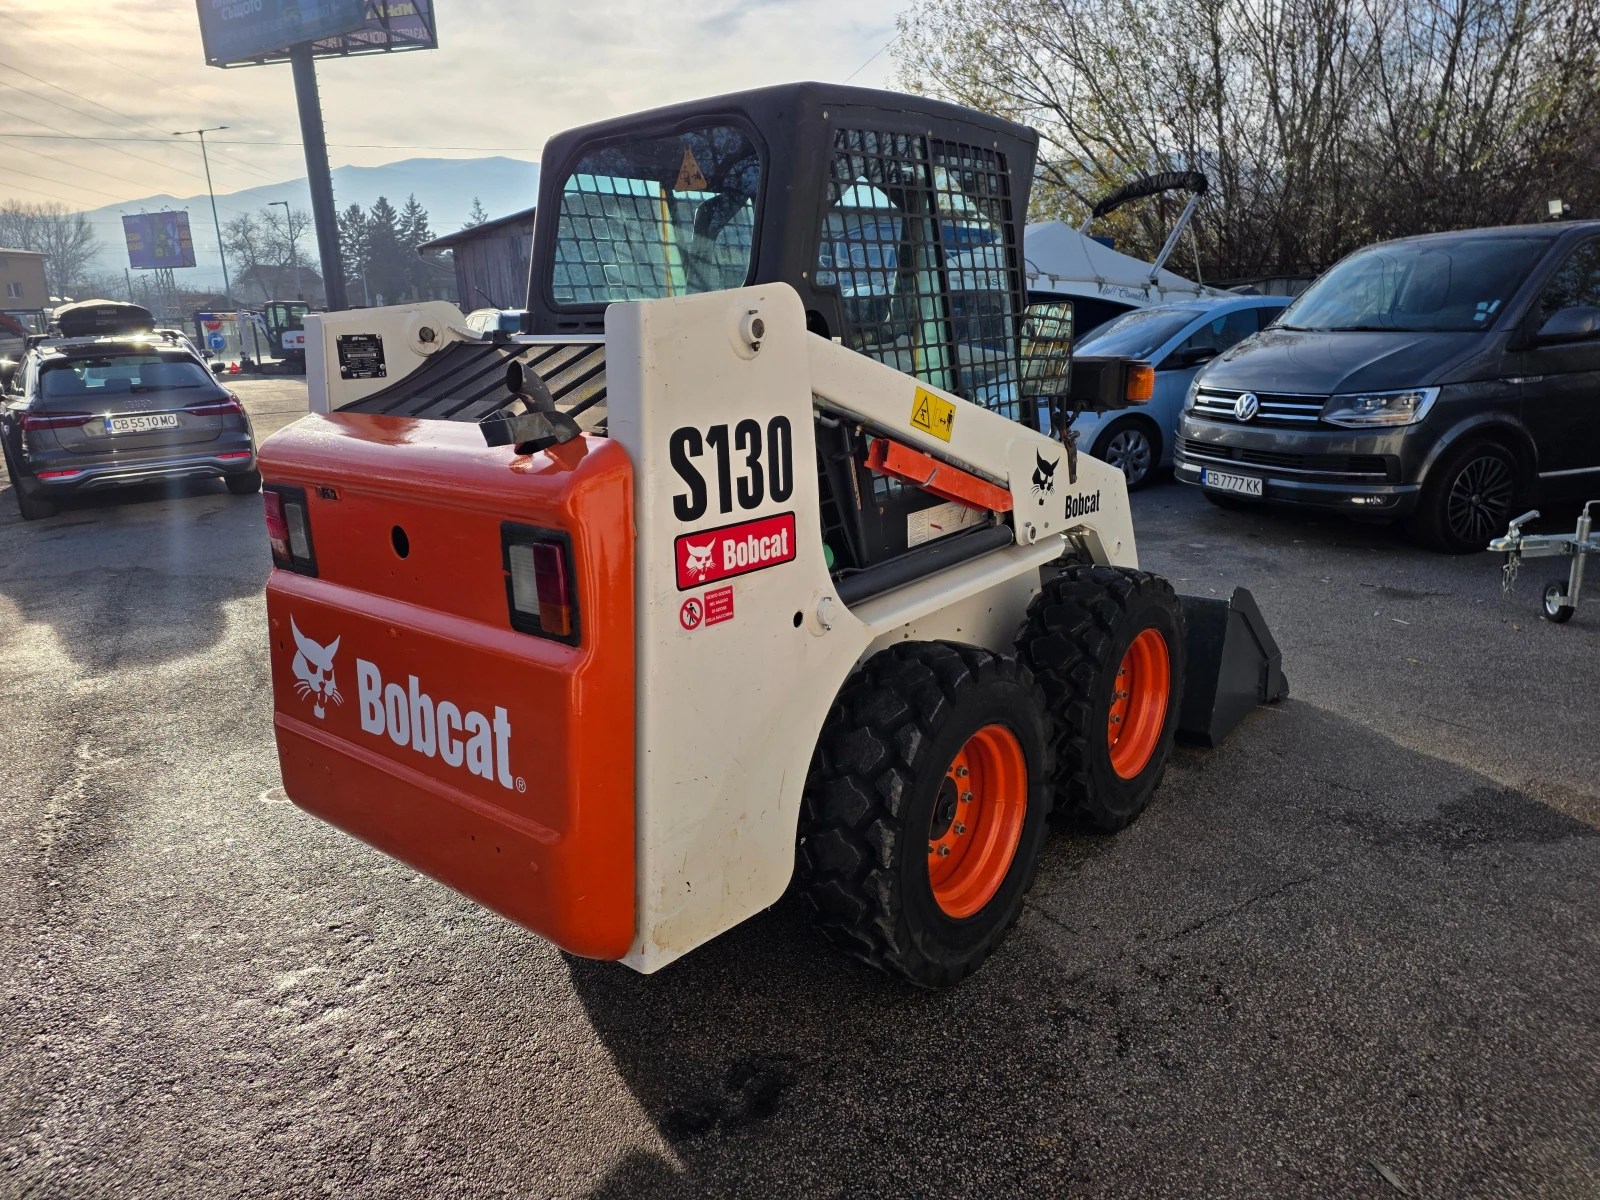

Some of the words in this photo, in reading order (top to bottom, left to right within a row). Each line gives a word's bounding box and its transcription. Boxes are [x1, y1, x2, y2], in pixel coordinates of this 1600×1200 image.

[221, 0, 262, 21] СЪЩОТО
[113, 419, 129, 430] CB
[130, 416, 159, 428] 5510
[159, 415, 176, 426] MO
[669, 415, 794, 522] S130
[1207, 472, 1220, 486] CB
[1221, 475, 1245, 490] 7777
[1246, 479, 1261, 494] KK
[1065, 489, 1101, 520] Bobcat
[722, 527, 788, 571] Bobcat
[356, 657, 514, 790] Bobcat
